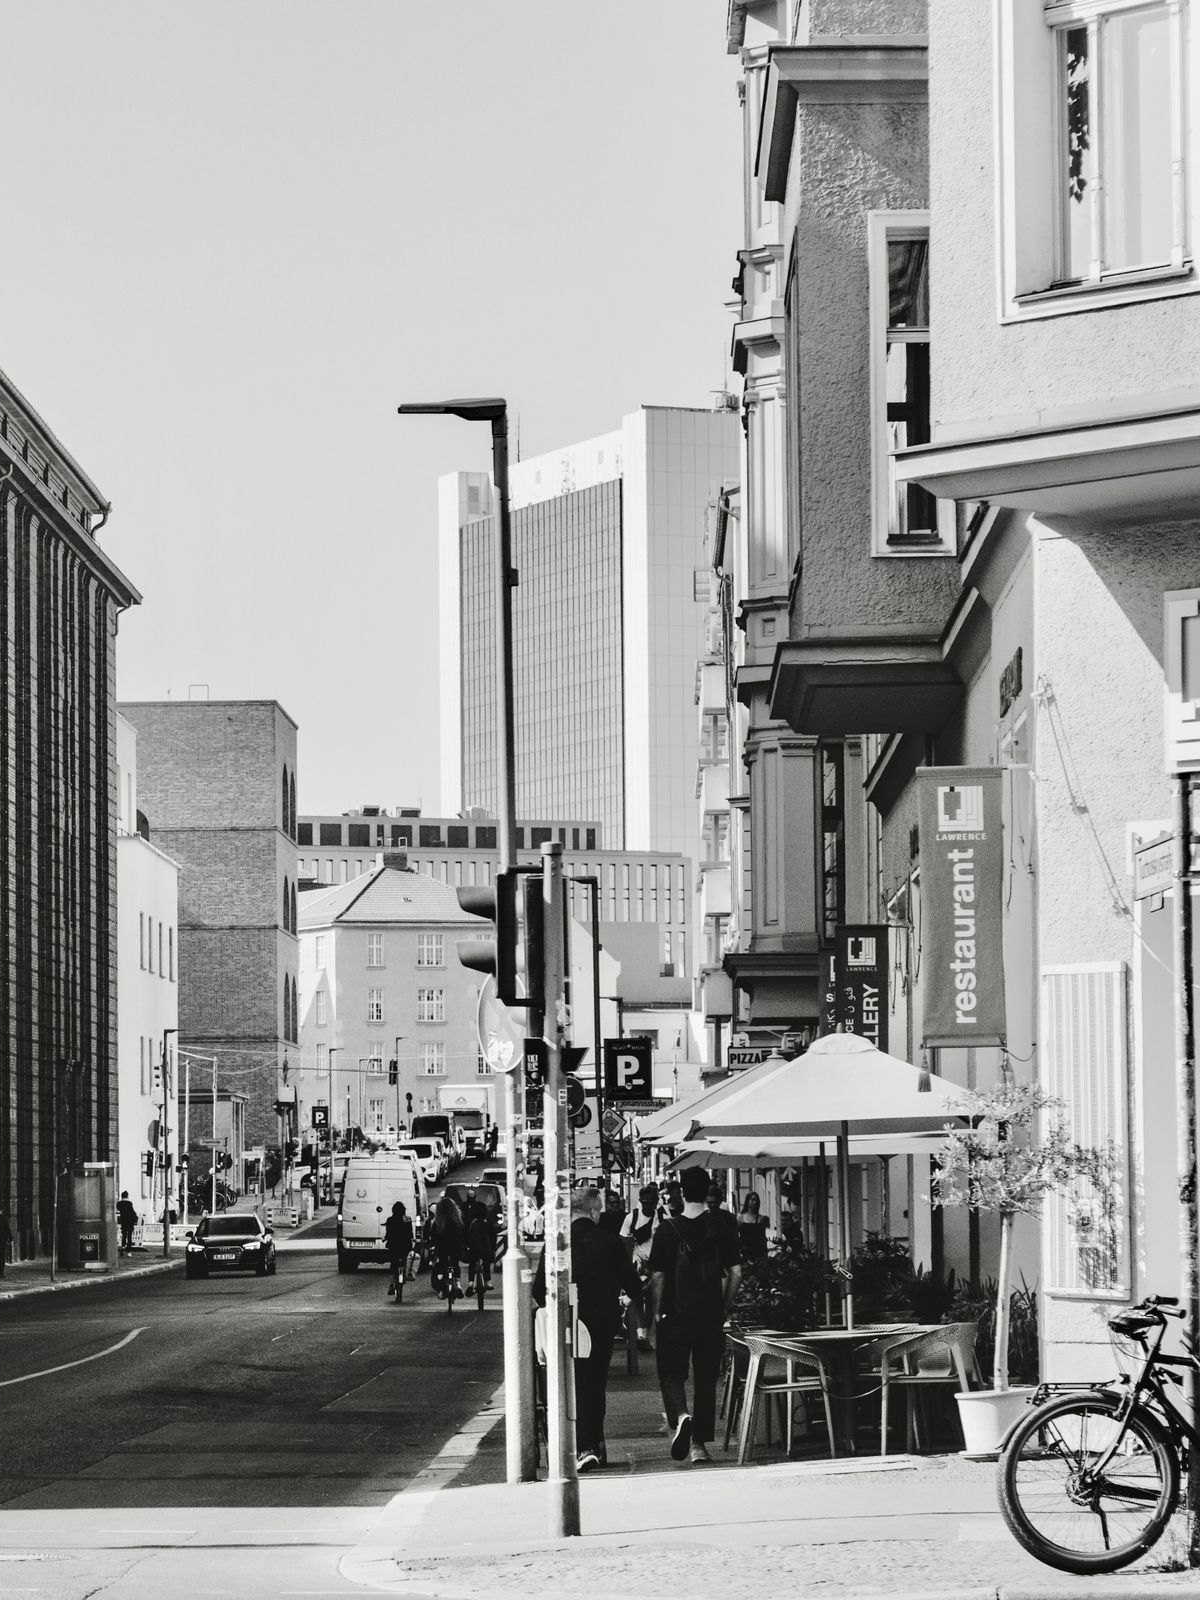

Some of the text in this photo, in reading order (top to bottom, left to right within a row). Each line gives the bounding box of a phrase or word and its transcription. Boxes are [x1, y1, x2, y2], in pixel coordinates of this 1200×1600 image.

[936, 833, 987, 841] LAWRENCE
[947, 848, 977, 1024] restaurant
[730, 1053, 762, 1064] PIZZA
[617, 1055, 640, 1086] P
[315, 1111, 325, 1124] P
